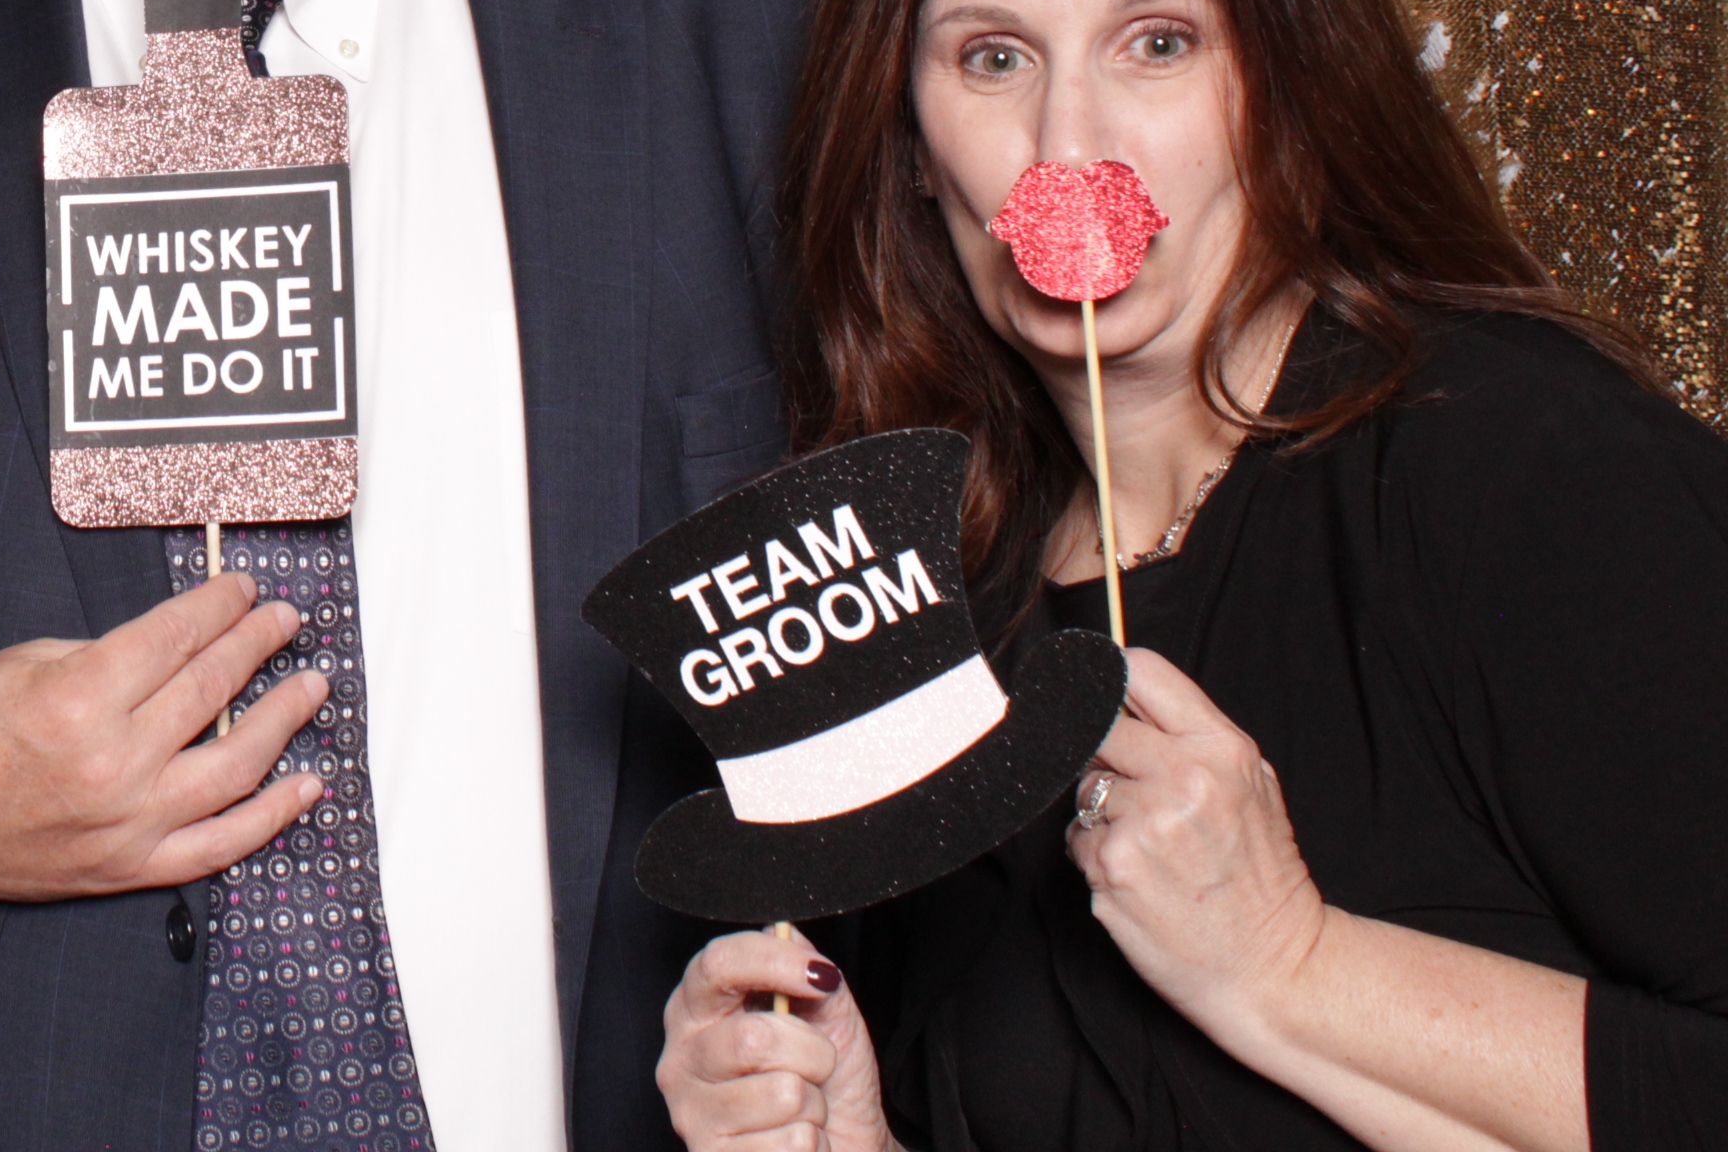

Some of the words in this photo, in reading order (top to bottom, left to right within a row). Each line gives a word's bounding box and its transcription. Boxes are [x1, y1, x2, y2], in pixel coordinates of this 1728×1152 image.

[86, 224, 313, 276] WHISKEY
[92, 277, 312, 346] MADE
[88, 355, 164, 399] ME
[183, 350, 264, 396] DO
[282, 347, 320, 391] IT
[670, 504, 875, 634] TEAM
[680, 549, 941, 706] GROOM
